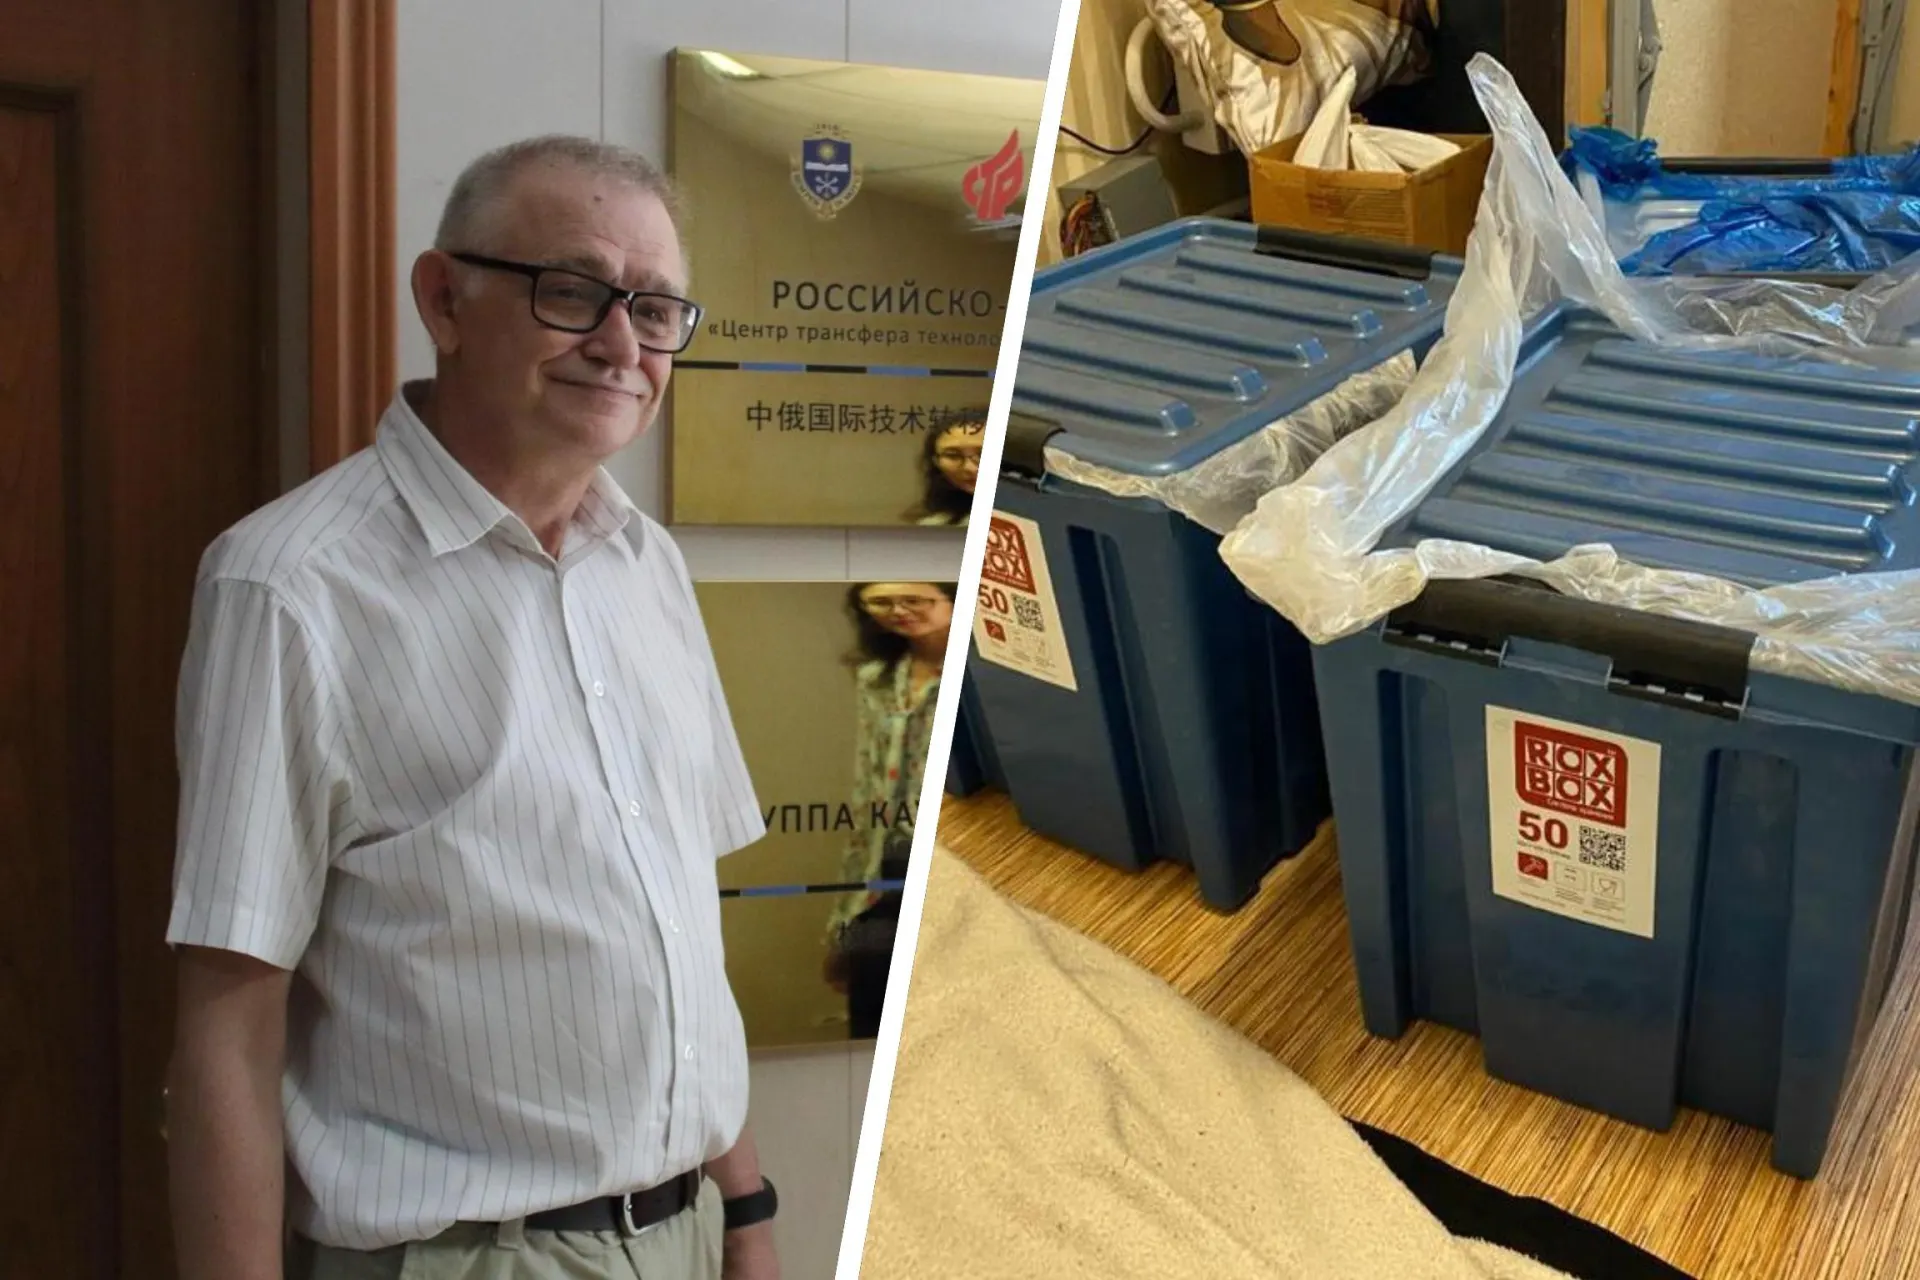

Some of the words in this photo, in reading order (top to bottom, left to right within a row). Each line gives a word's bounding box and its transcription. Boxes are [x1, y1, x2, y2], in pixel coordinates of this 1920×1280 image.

[772, 279, 1006, 318] РОССИЙСКО-
[708, 319, 788, 341] «Центр
[796, 323, 909, 346] трансфера
[918, 329, 1001, 348] техноло
[979, 583, 1009, 615] 50
[1526, 737, 1616, 784] ROX
[1526, 765, 1616, 811] BOX
[870, 799, 920, 829] КА
[1518, 810, 1569, 849] 50
